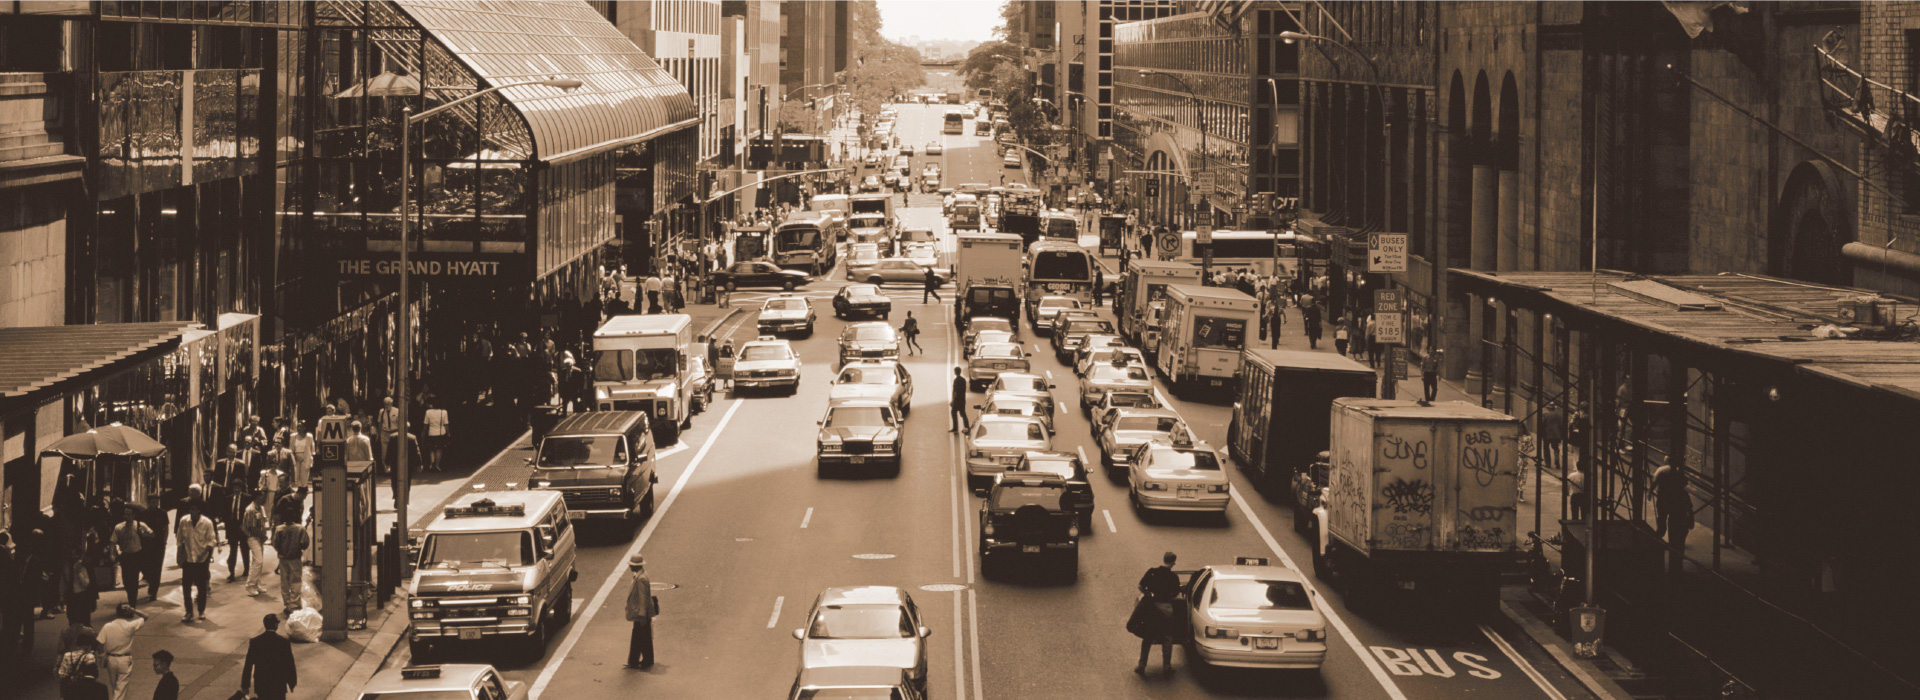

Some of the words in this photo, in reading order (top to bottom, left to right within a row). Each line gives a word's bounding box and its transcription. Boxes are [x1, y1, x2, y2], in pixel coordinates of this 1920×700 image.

[1380, 237, 1405, 245] BUSES
[337, 260, 371, 274] THE
[376, 260, 442, 275] GRAND
[447, 261, 500, 276] HYATT
[1380, 292, 1396, 301] RED
[1378, 302, 1398, 311] ZONE
[1378, 327, 1400, 336] $185
[323, 422, 343, 439] M
[447, 583, 493, 592] POLICE
[1369, 645, 1502, 680] BUS
